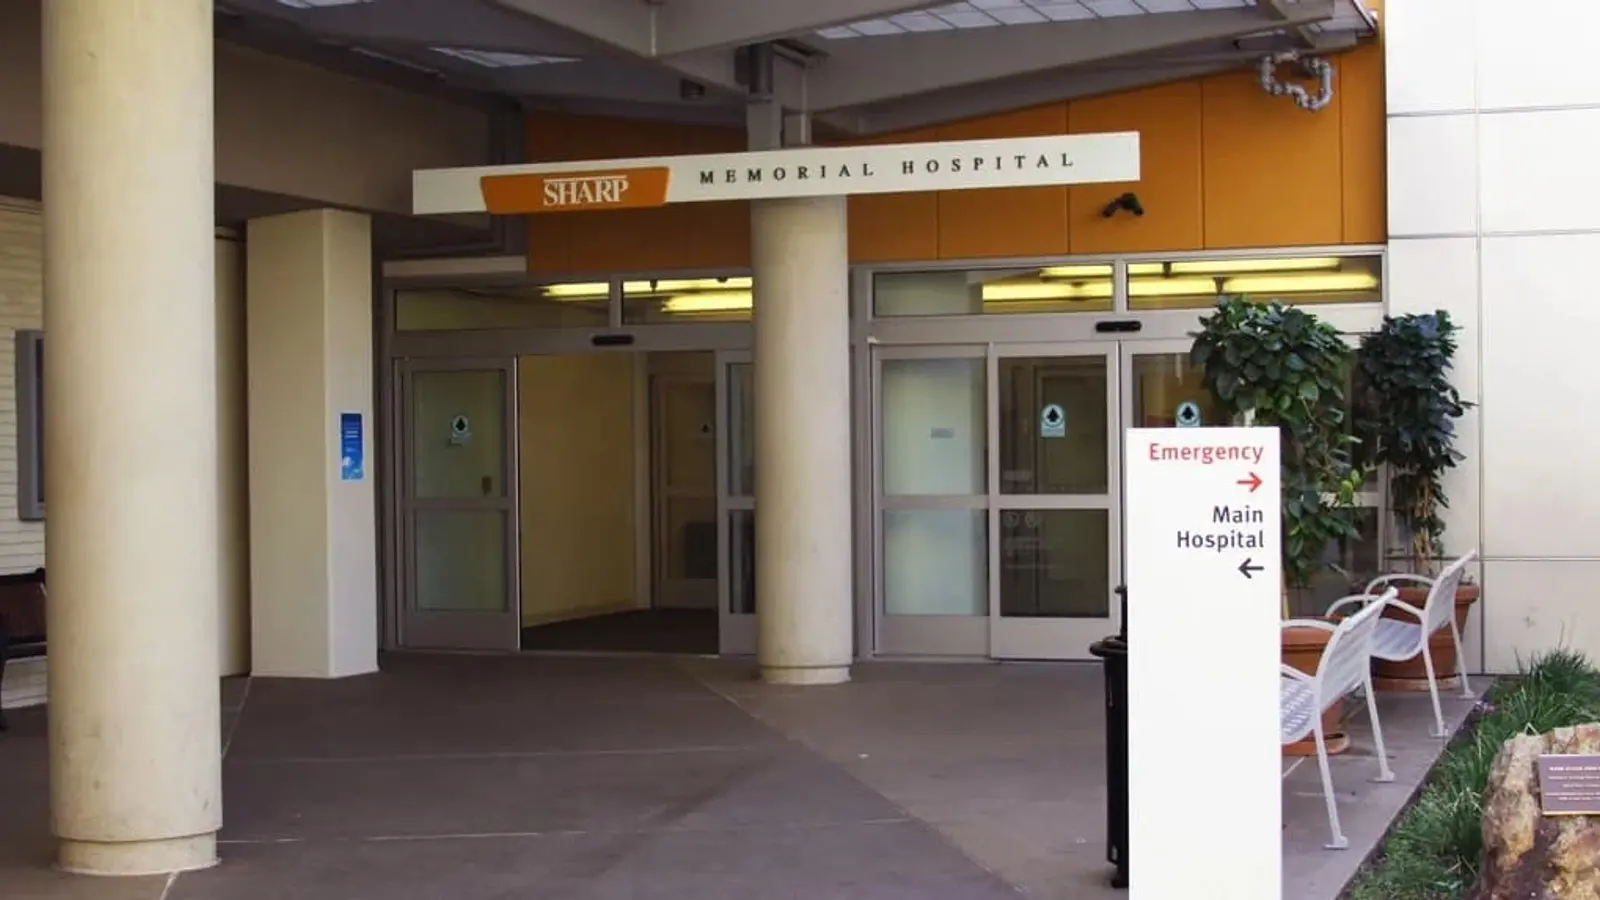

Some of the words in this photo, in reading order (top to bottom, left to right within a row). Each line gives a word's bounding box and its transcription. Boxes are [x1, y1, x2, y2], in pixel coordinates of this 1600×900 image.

[543, 178, 629, 206] SHARP
[699, 162, 875, 184] MEMORIAL
[902, 153, 1074, 175] HOSPITAL
[1149, 442, 1264, 465] Emergency
[1212, 505, 1264, 524] Main
[1176, 530, 1265, 553] Hospital
